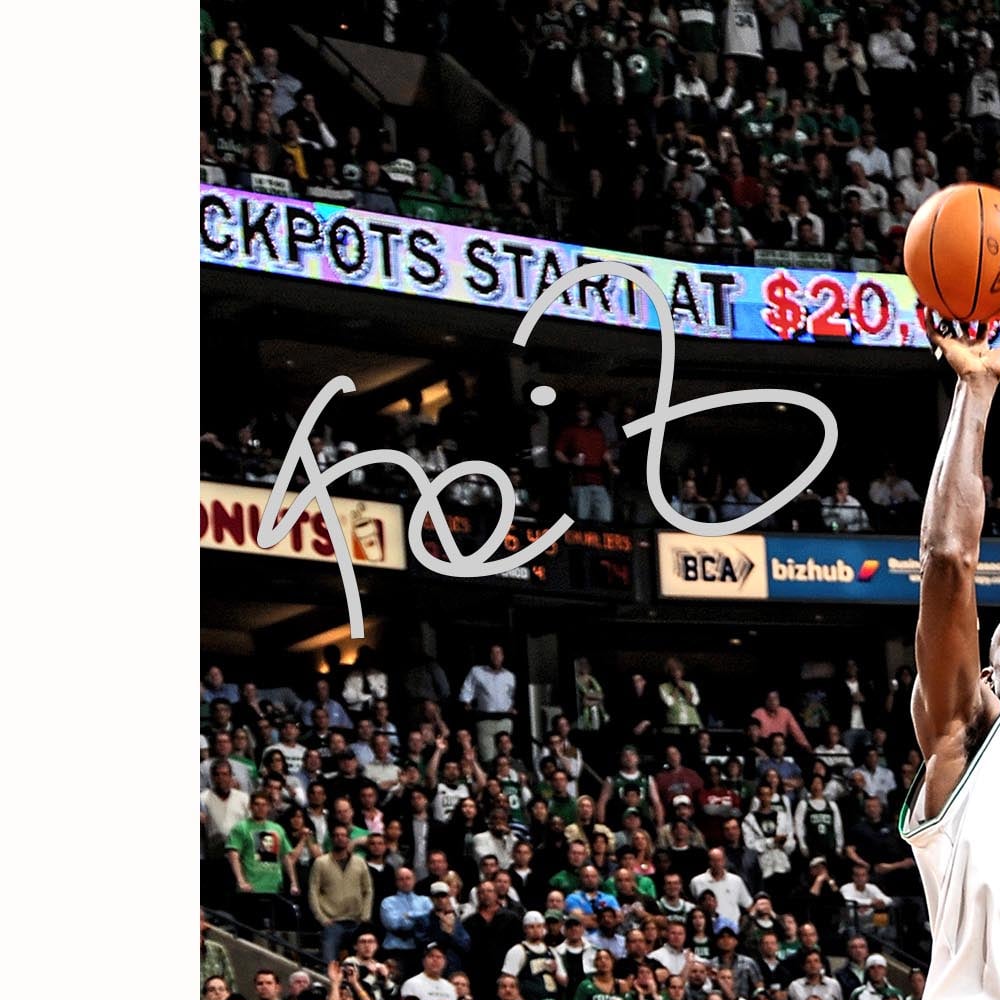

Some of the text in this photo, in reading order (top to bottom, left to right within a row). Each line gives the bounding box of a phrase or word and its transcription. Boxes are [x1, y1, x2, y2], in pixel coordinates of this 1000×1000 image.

[464, 238, 646, 317] START
[672, 271, 738, 326] AT
[200, 500, 336, 557] NTS
[683, 556, 737, 581] BCA
[771, 557, 855, 583] bizhub
